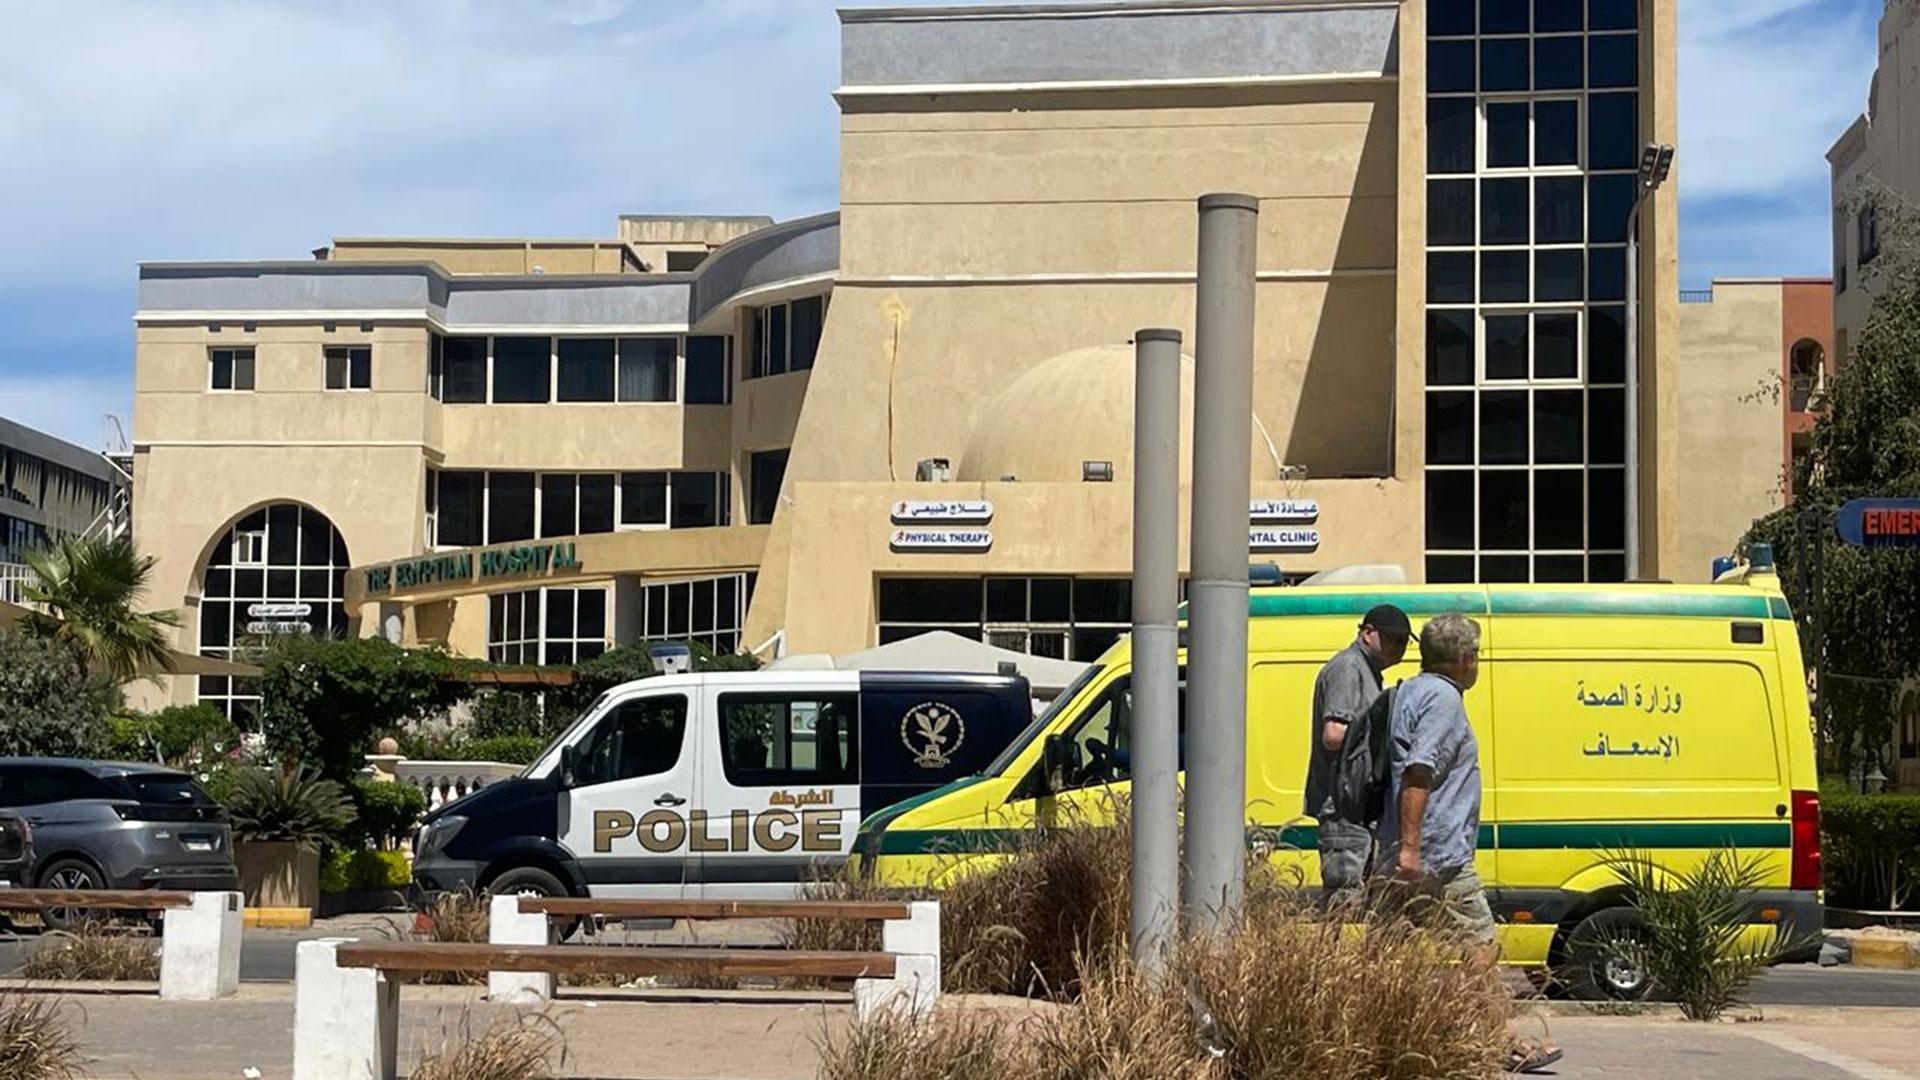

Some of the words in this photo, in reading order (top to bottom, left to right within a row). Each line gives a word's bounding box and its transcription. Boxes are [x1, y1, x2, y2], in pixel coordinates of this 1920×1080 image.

[949, 502, 987, 516] علاج
[1281, 502, 1318, 516] عيادة
[1864, 508, 1920, 535] EMER
[904, 532, 947, 543] PHYSICAL
[949, 532, 989, 543] THERAPY
[1279, 532, 1318, 543] CLINIC
[366, 565, 391, 592] THE
[395, 552, 473, 588] EGYPTIAN
[480, 541, 583, 577] HOSPITAL
[1577, 679, 1628, 706] الصحة
[1635, 683, 1682, 714] وزارة
[769, 788, 833, 809] الشرطة
[593, 808, 843, 853] POLICE
